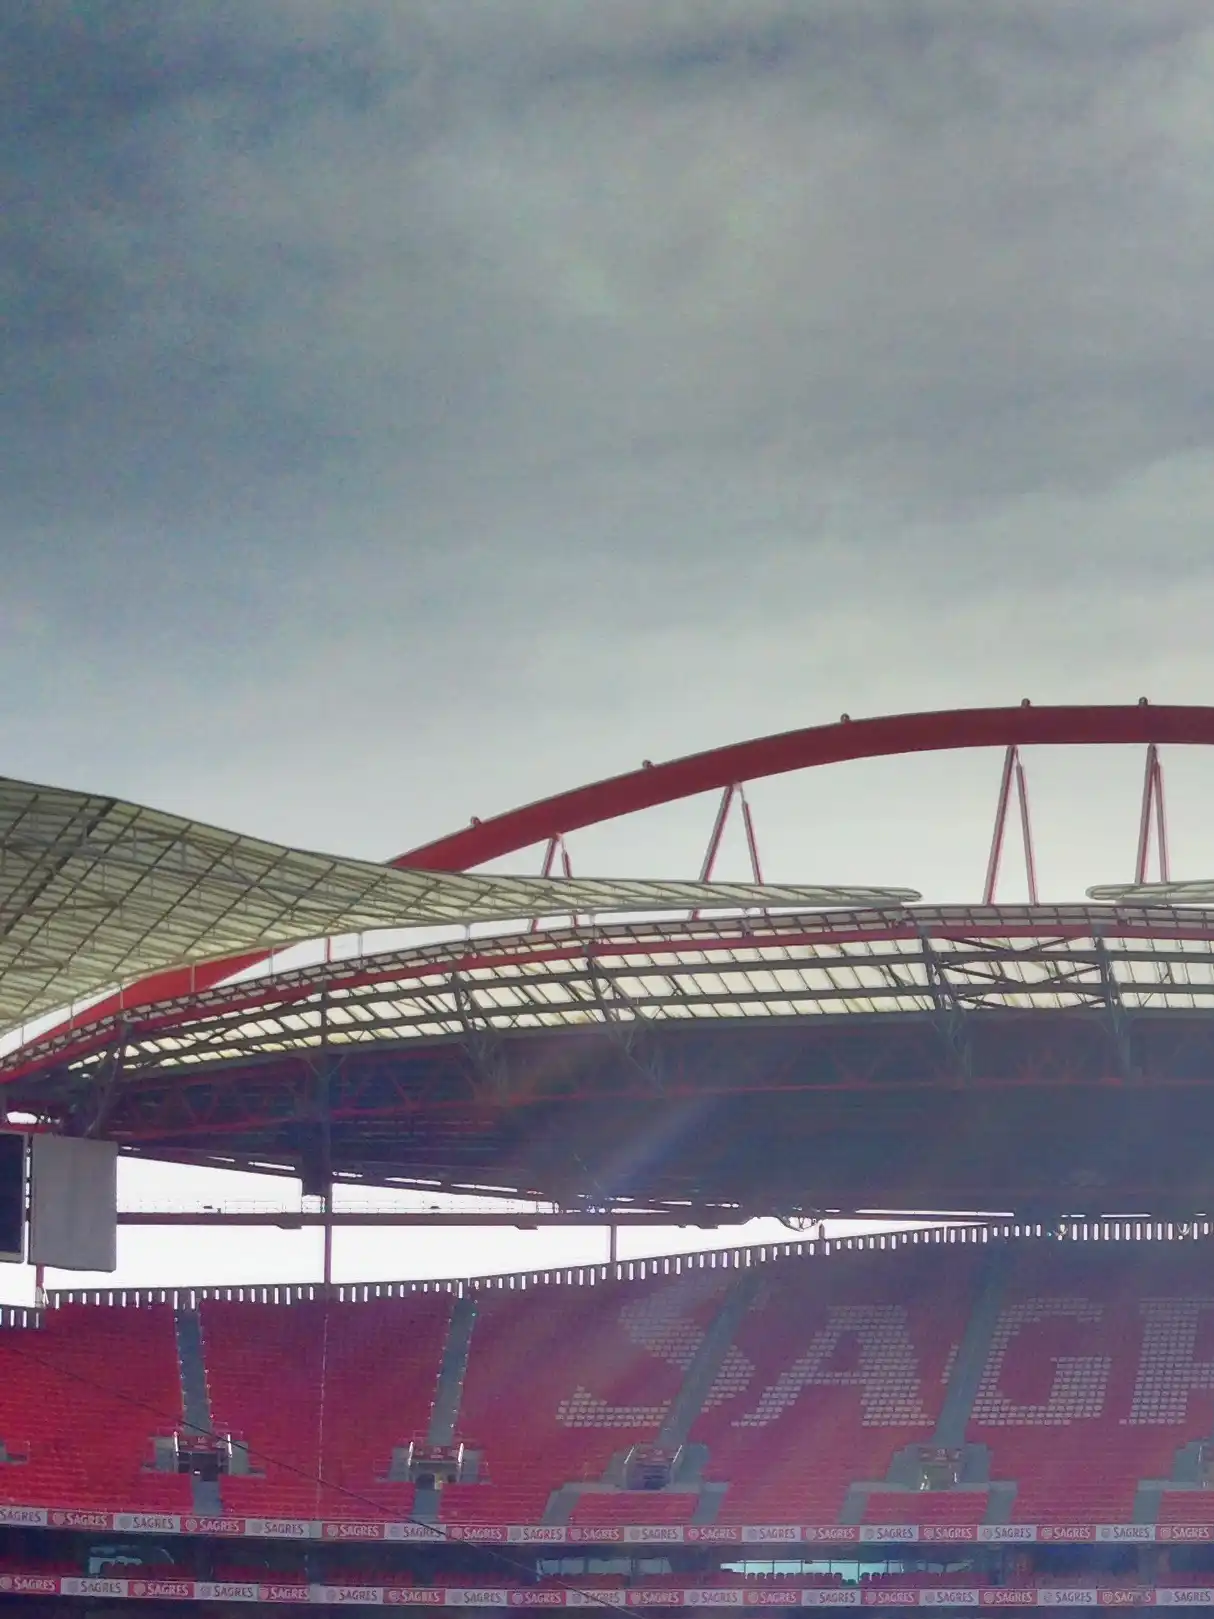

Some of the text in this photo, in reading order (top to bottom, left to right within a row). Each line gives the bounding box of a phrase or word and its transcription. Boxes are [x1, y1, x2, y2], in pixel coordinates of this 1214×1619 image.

[65, 1512, 107, 1527] SAGRES
[133, 1516, 174, 1530] SAGRES
[199, 1518, 240, 1531] SAGRES
[264, 1522, 304, 1535] SAGRES
[339, 1524, 380, 1537] SAGRES
[464, 1526, 502, 1540] SAGRES
[523, 1527, 563, 1541] SAGRES
[581, 1527, 619, 1540] SAGRES
[640, 1527, 678, 1540] SAGRES
[700, 1527, 737, 1540] SAGRES
[759, 1526, 795, 1539] SAGRES
[817, 1527, 855, 1539] SAGRES
[877, 1526, 913, 1539] SAGRES
[936, 1526, 972, 1539] SAGRES
[994, 1526, 1031, 1539] SAGRES
[1054, 1526, 1090, 1539] SAGRES
[1112, 1526, 1150, 1539] SAGRES
[1172, 1525, 1209, 1539] SAGRES
[14, 1577, 55, 1590] SAGRES
[81, 1580, 122, 1594] SAGRES
[147, 1583, 189, 1597] SAGRES
[214, 1585, 253, 1599] SAGRES
[270, 1586, 309, 1601] SAGRES
[339, 1588, 378, 1602] SAGRES
[401, 1589, 440, 1603] SAGRES
[464, 1590, 501, 1604] SAGRES
[524, 1590, 561, 1604] SAGRES
[641, 1590, 679, 1603] SAGRES
[701, 1590, 737, 1603] SAGRES
[760, 1590, 796, 1603] SAGRES
[819, 1590, 856, 1603] SAGRES
[878, 1590, 915, 1603] SAGRES
[937, 1590, 974, 1603] SAGRES
[996, 1590, 1033, 1603] SAGRES
[1055, 1590, 1092, 1603] SAGRES
[1115, 1590, 1151, 1603] SAGS
[1174, 1589, 1210, 1603] SAGRES
